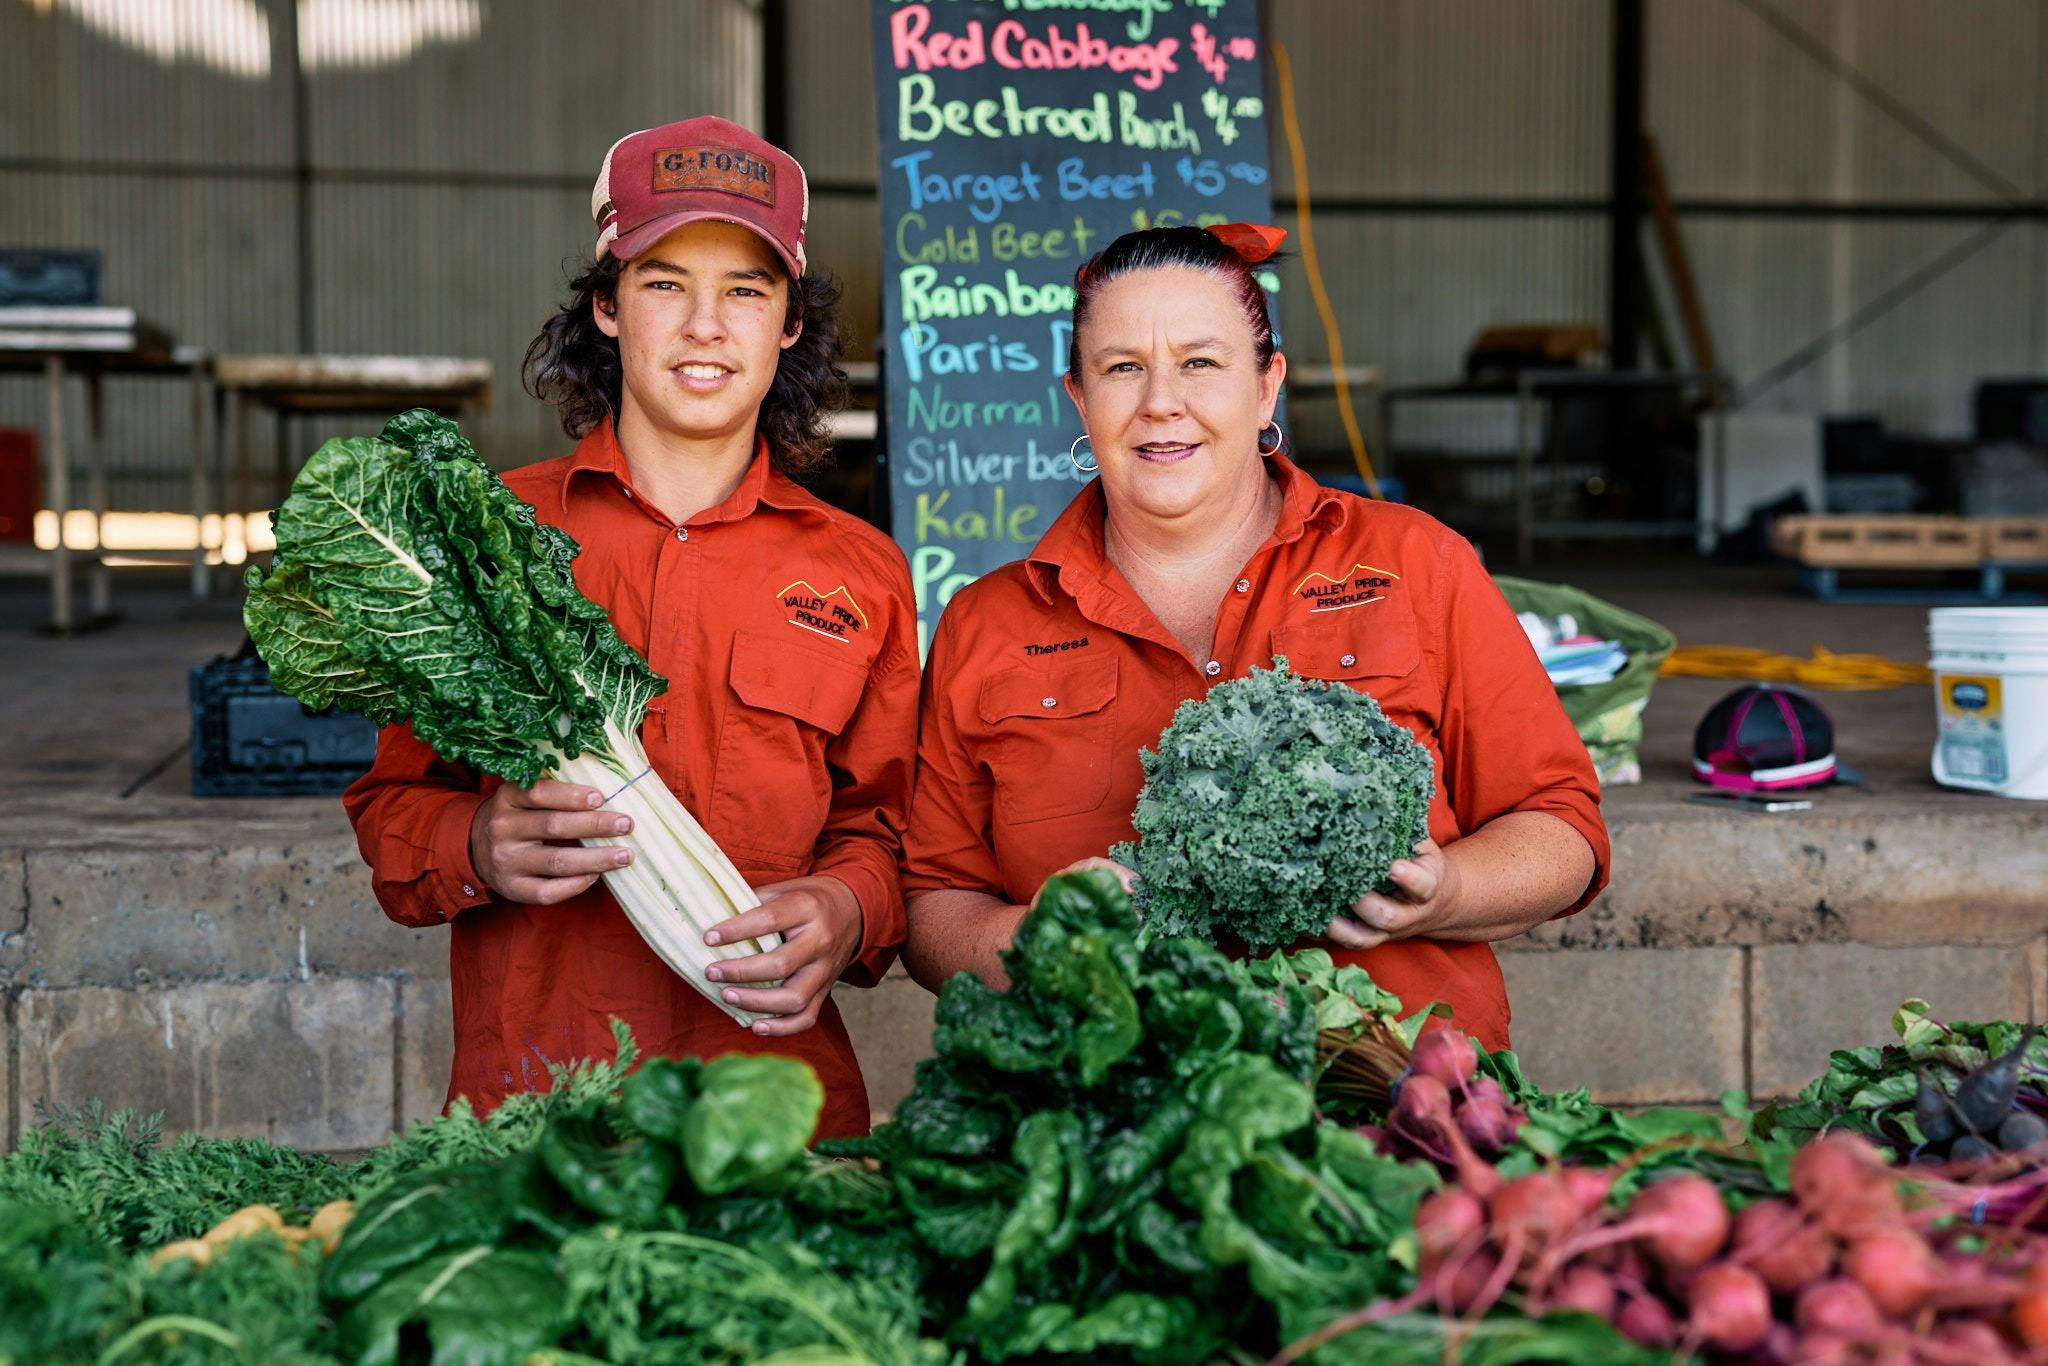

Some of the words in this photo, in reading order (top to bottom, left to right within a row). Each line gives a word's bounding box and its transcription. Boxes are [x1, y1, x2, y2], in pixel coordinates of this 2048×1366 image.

[890, 4, 985, 72] Red
[991, 19, 1180, 91] Cabbage
[892, 150, 1041, 223] Target
[1057, 158, 1156, 200] Beet
[991, 215, 1097, 262] Beet
[899, 323, 1039, 382] Paris
[907, 384, 1060, 432] Normal
[915, 487, 1040, 546] Kale
[1300, 583, 1347, 600] VALLEY
[1354, 577, 1391, 589] PRIDE
[1316, 589, 1376, 607] PRODUCE
[784, 596, 828, 612] VALLEY
[831, 605, 861, 632] PRIDE
[795, 609, 845, 635] PRODUCE
[1023, 637, 1089, 656] Theresa
